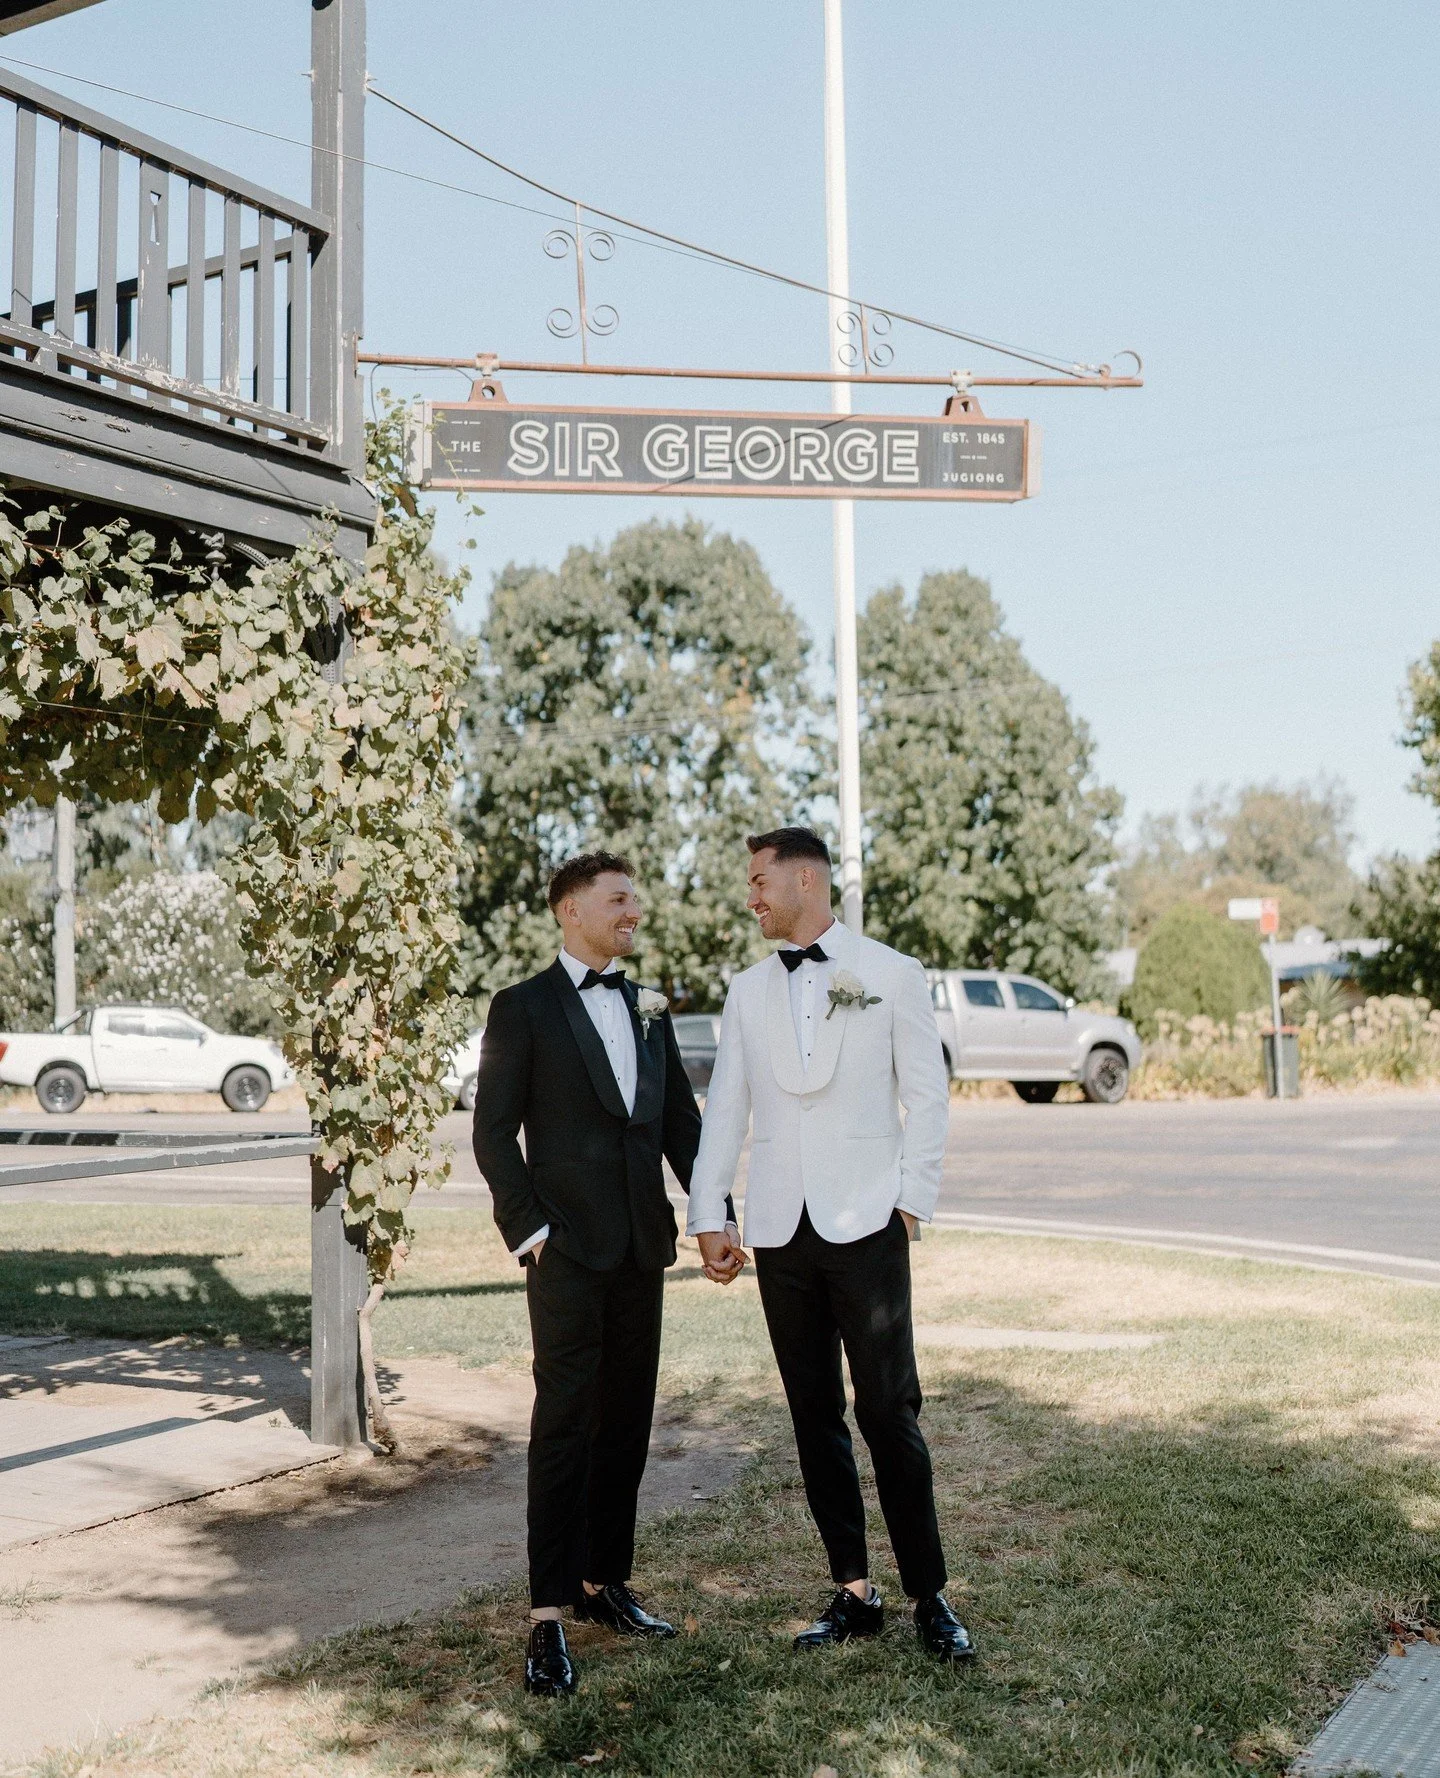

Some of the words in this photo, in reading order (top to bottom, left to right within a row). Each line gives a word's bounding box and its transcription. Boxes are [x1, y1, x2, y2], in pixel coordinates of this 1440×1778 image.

[942, 432, 969, 444] EST.
[976, 432, 1005, 445] 1845
[450, 440, 481, 453] THE
[507, 420, 623, 478] SIR
[642, 423, 919, 484] GEORGE
[942, 472, 1005, 484] JUGIONG
